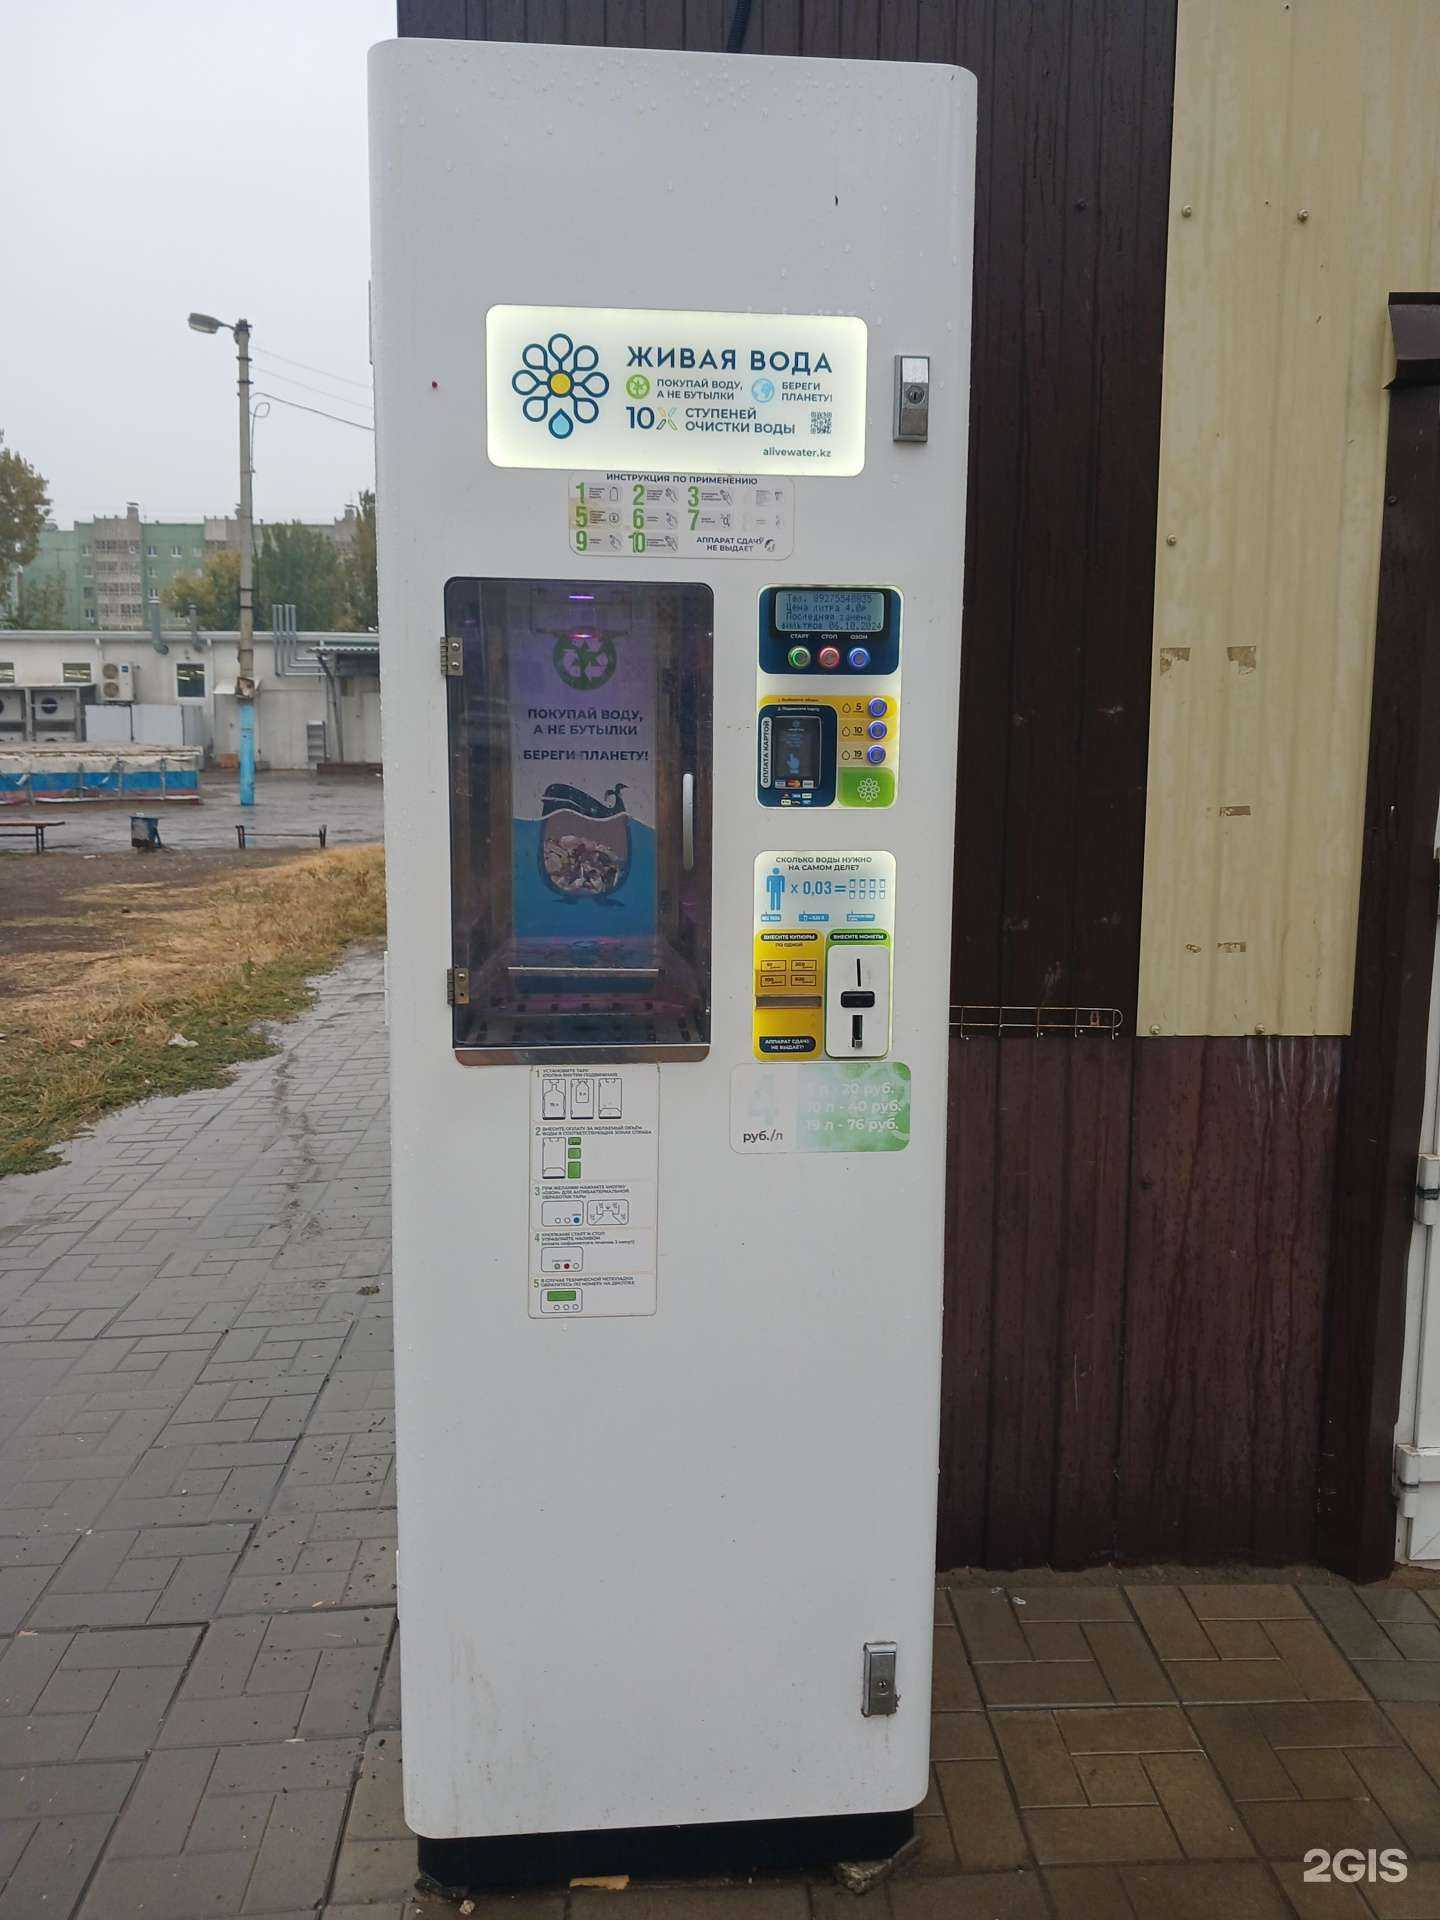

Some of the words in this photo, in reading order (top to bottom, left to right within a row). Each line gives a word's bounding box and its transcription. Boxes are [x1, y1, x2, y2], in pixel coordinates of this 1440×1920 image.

[626, 346, 736, 371] ЖИВАЯ
[750, 350, 833, 376] ВОДА
[656, 378, 709, 388] ПОКУПАЙ
[712, 381, 743, 391] ВОДУ,
[781, 382, 821, 391] БЕРЕГИ
[656, 391, 664, 399] А
[667, 391, 681, 399] НЕ
[684, 391, 735, 401] БУТЫЛКИ
[781, 393, 833, 403] ПЛАНЕТУ!
[685, 407, 757, 420] СТУПЕНЕЙ
[685, 422, 751, 433] ОЧИСТКИ
[754, 424, 796, 436] ВОДЫ
[762, 446, 832, 458] alivewater.kz
[606, 473, 670, 484] ИНСТРУКЦИЯ
[673, 475, 687, 483] ПО
[689, 475, 758, 485] ПРИМЕНЕНИЮ
[576, 482, 585, 504] 1
[632, 484, 645, 506] 2
[688, 485, 700, 507] 3
[575, 506, 588, 528] 5
[632, 508, 645, 529] 6
[688, 508, 700, 531] 7
[575, 530, 587, 552] 9
[628, 531, 646, 553] 10
[696, 536, 735, 545] АППАРАТ
[737, 537, 764, 546] СДАЧУ
[786, 603, 808, 612] Цена
[813, 604, 840, 613] литра
[786, 612, 835, 622] Последняя
[527, 707, 597, 720] ПОКУПАЙ
[600, 709, 644, 722] ВОДУ,
[533, 725, 543, 735] А
[547, 725, 566, 735] НЕ
[570, 725, 637, 736] БУТЫЛКИ
[762, 718, 770, 751] КАРТОЙ
[523, 750, 576, 761] БЕРЕГИ
[580, 750, 649, 761] ПЛАНЕТУ!
[762, 752, 770, 784] ОПЛАТА
[815, 856, 840, 865] ВОДЫ
[833, 864, 860, 872] ДЕЛЕ?
[864, 1081, 896, 1100] руб.
[807, 1102, 822, 1113] 10
[825, 1104, 835, 1113] л
[871, 1100, 902, 1116] руб.
[535, 1127, 541, 1136] 2
[823, 1121, 834, 1131] л
[847, 1119, 864, 1131] 76
[868, 1117, 899, 1134] руб.
[742, 1129, 784, 1145] руб./л
[535, 1187, 540, 1196] 3
[534, 1279, 539, 1288] 5
